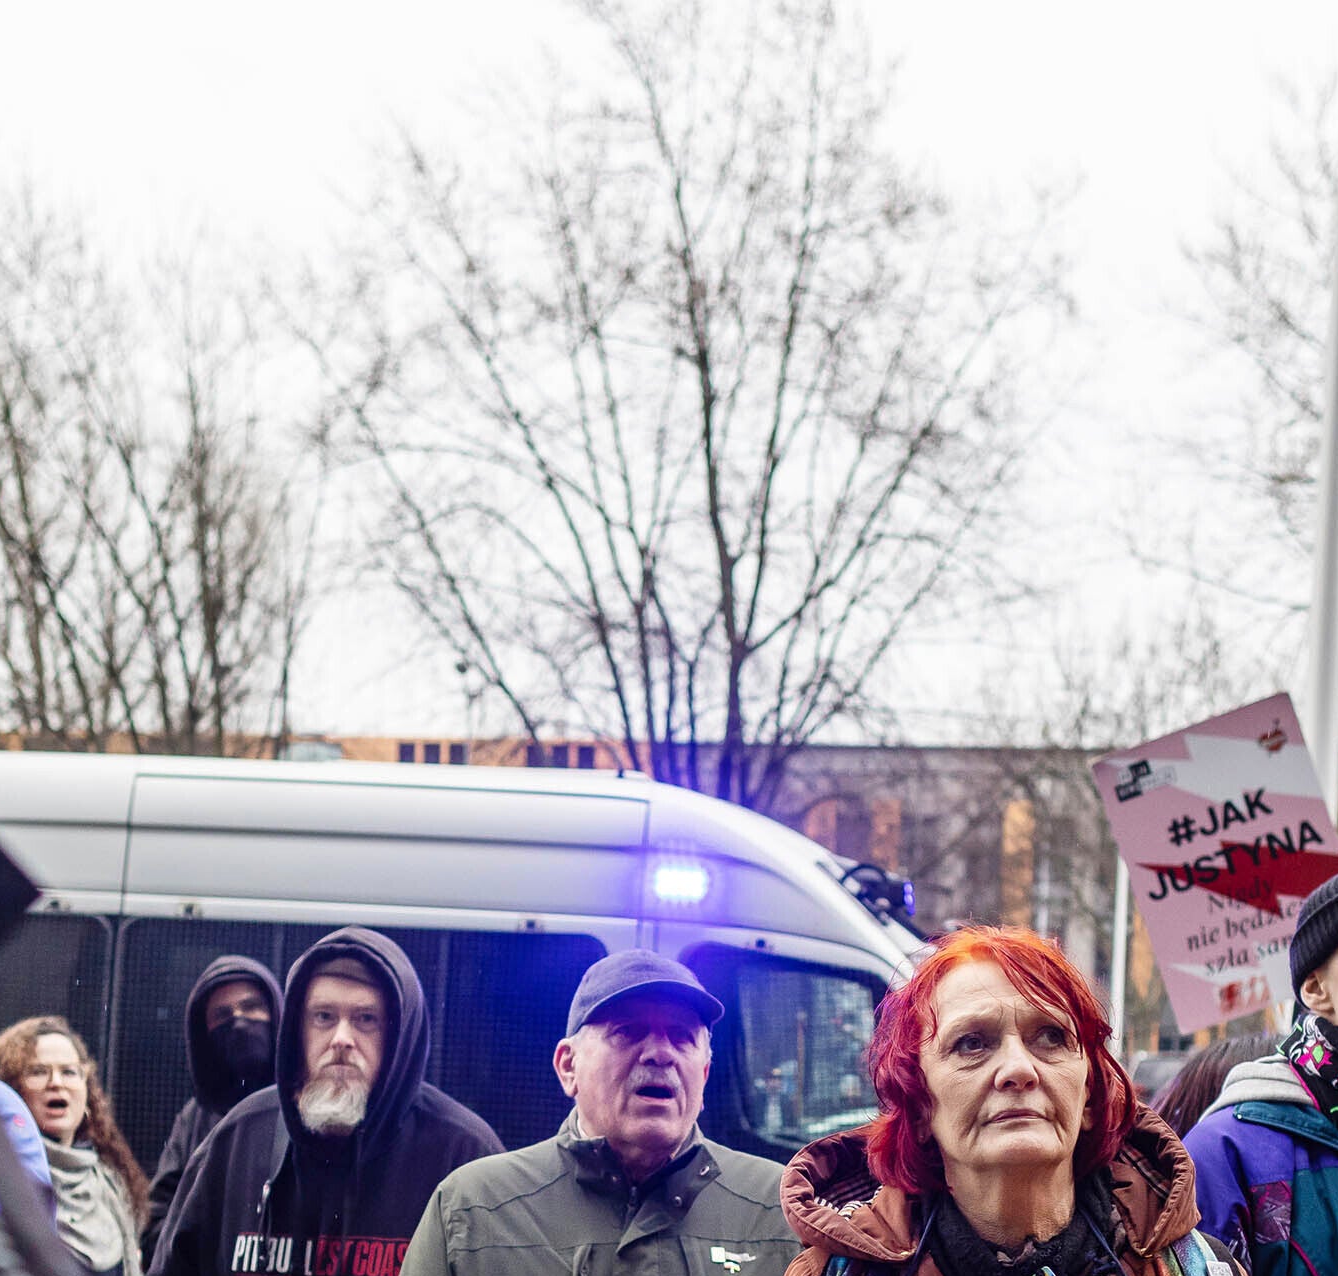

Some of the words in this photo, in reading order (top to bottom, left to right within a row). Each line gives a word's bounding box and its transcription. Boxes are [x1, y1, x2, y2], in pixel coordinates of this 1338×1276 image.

[1168, 788, 1273, 847] #JAK
[1149, 820, 1324, 900] JUSTYNA
[1186, 924, 1218, 952] nie
[1205, 945, 1249, 976] szła
